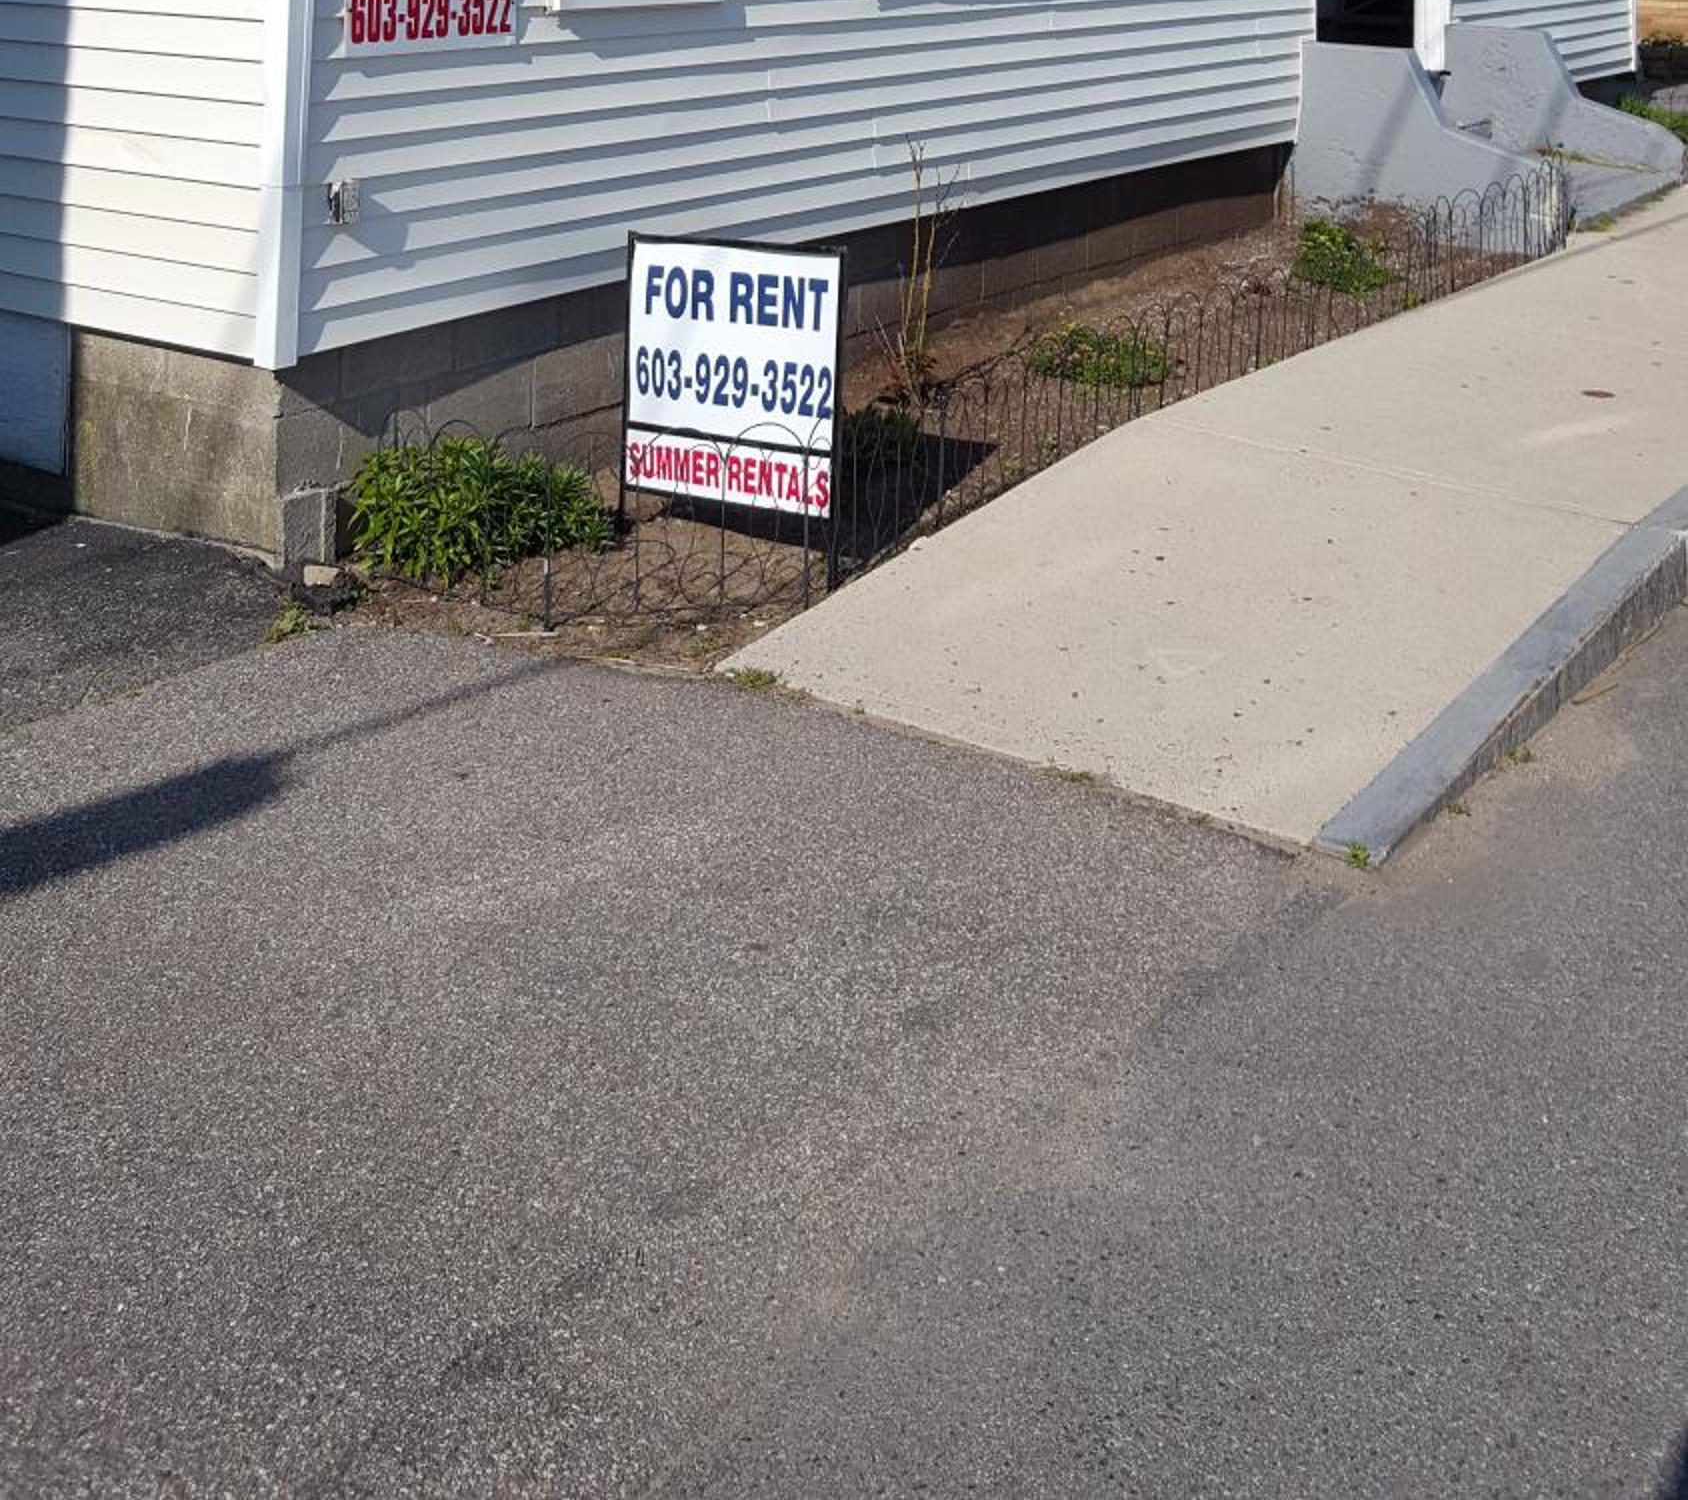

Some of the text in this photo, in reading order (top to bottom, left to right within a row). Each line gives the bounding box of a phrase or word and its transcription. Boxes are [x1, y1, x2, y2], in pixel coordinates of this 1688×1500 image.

[645, 265, 829, 331] FOR RENT
[636, 346, 833, 420] 603-929-3522
[629, 442, 720, 488] SUMMER
